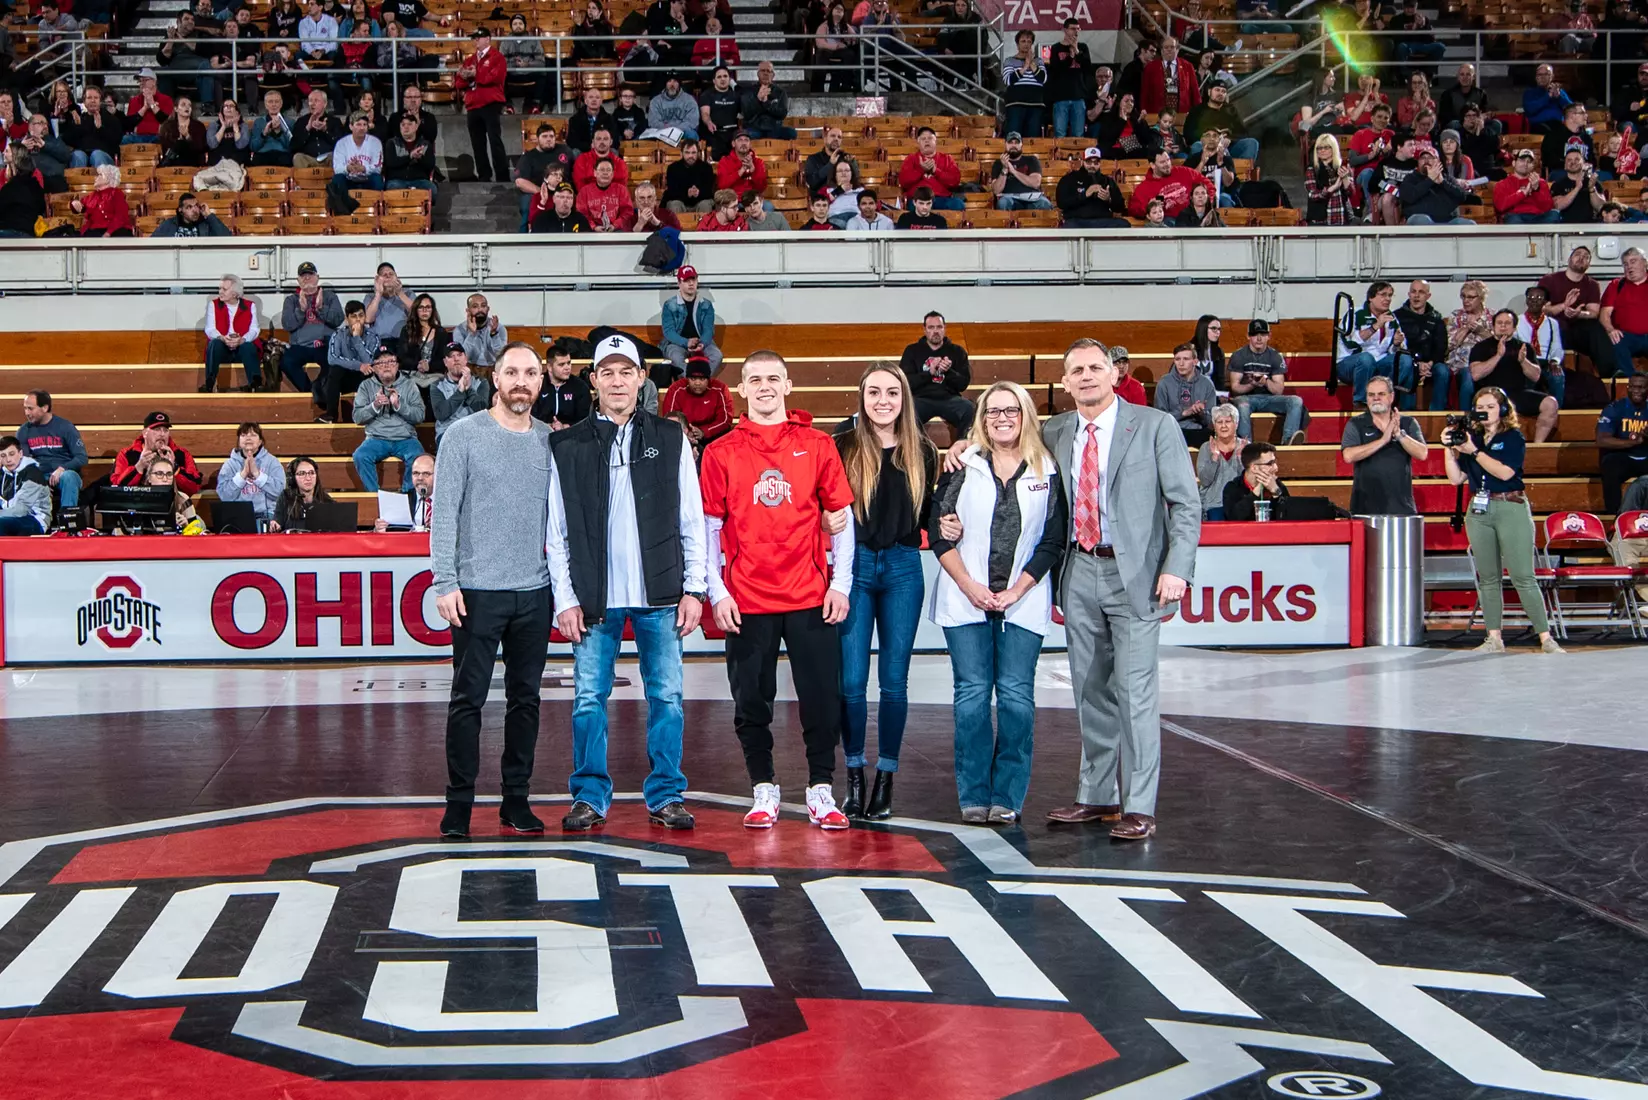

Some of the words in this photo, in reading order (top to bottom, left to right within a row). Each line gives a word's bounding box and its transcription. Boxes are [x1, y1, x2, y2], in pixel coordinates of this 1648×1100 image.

[1005, 0, 1093, 24] 7A-5A
[862, 101, 880, 114] 7A
[764, 140, 772, 148] 11
[1028, 482, 1049, 492] USA
[1161, 571, 1317, 624] ucks
